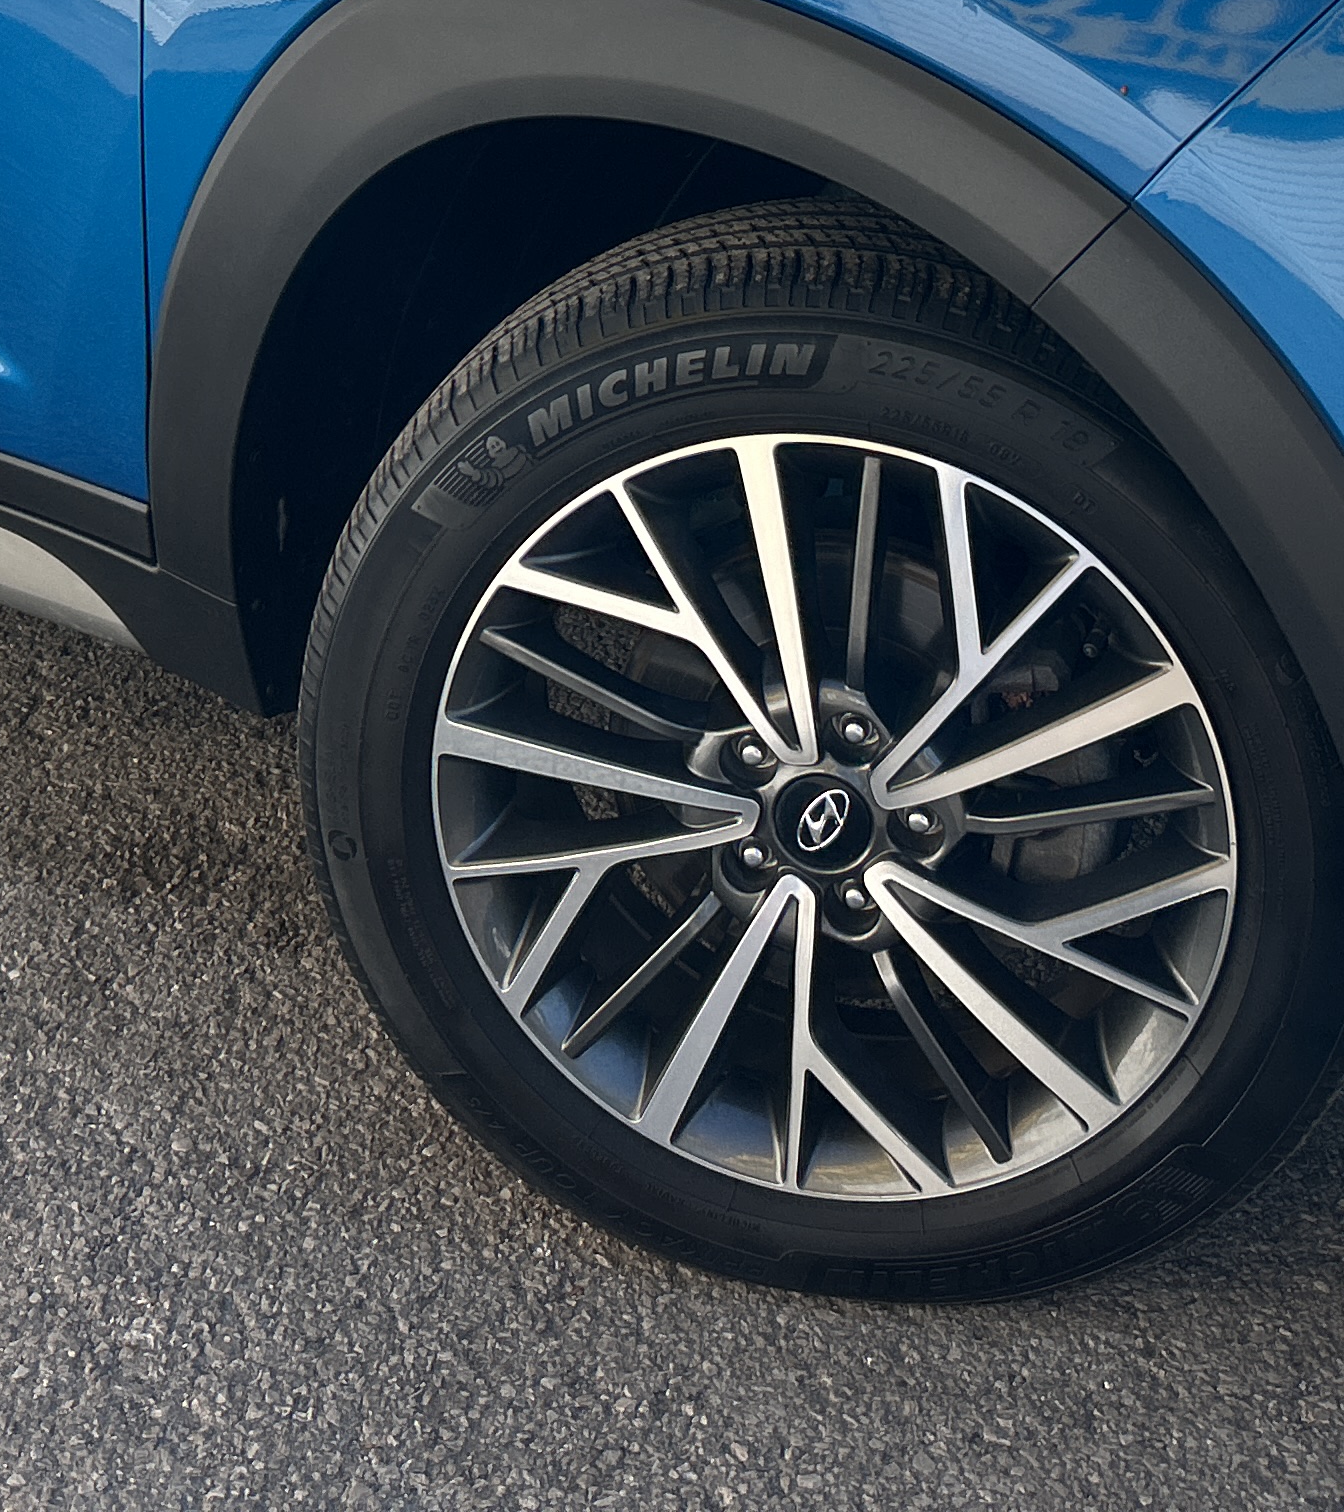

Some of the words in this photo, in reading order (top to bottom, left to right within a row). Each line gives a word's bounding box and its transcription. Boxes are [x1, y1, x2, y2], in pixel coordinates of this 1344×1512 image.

[527, 340, 817, 449] MICHELIN
[868, 350, 1006, 410] 225/55
[1011, 397, 1042, 427] R
[1051, 420, 1090, 452] 18
